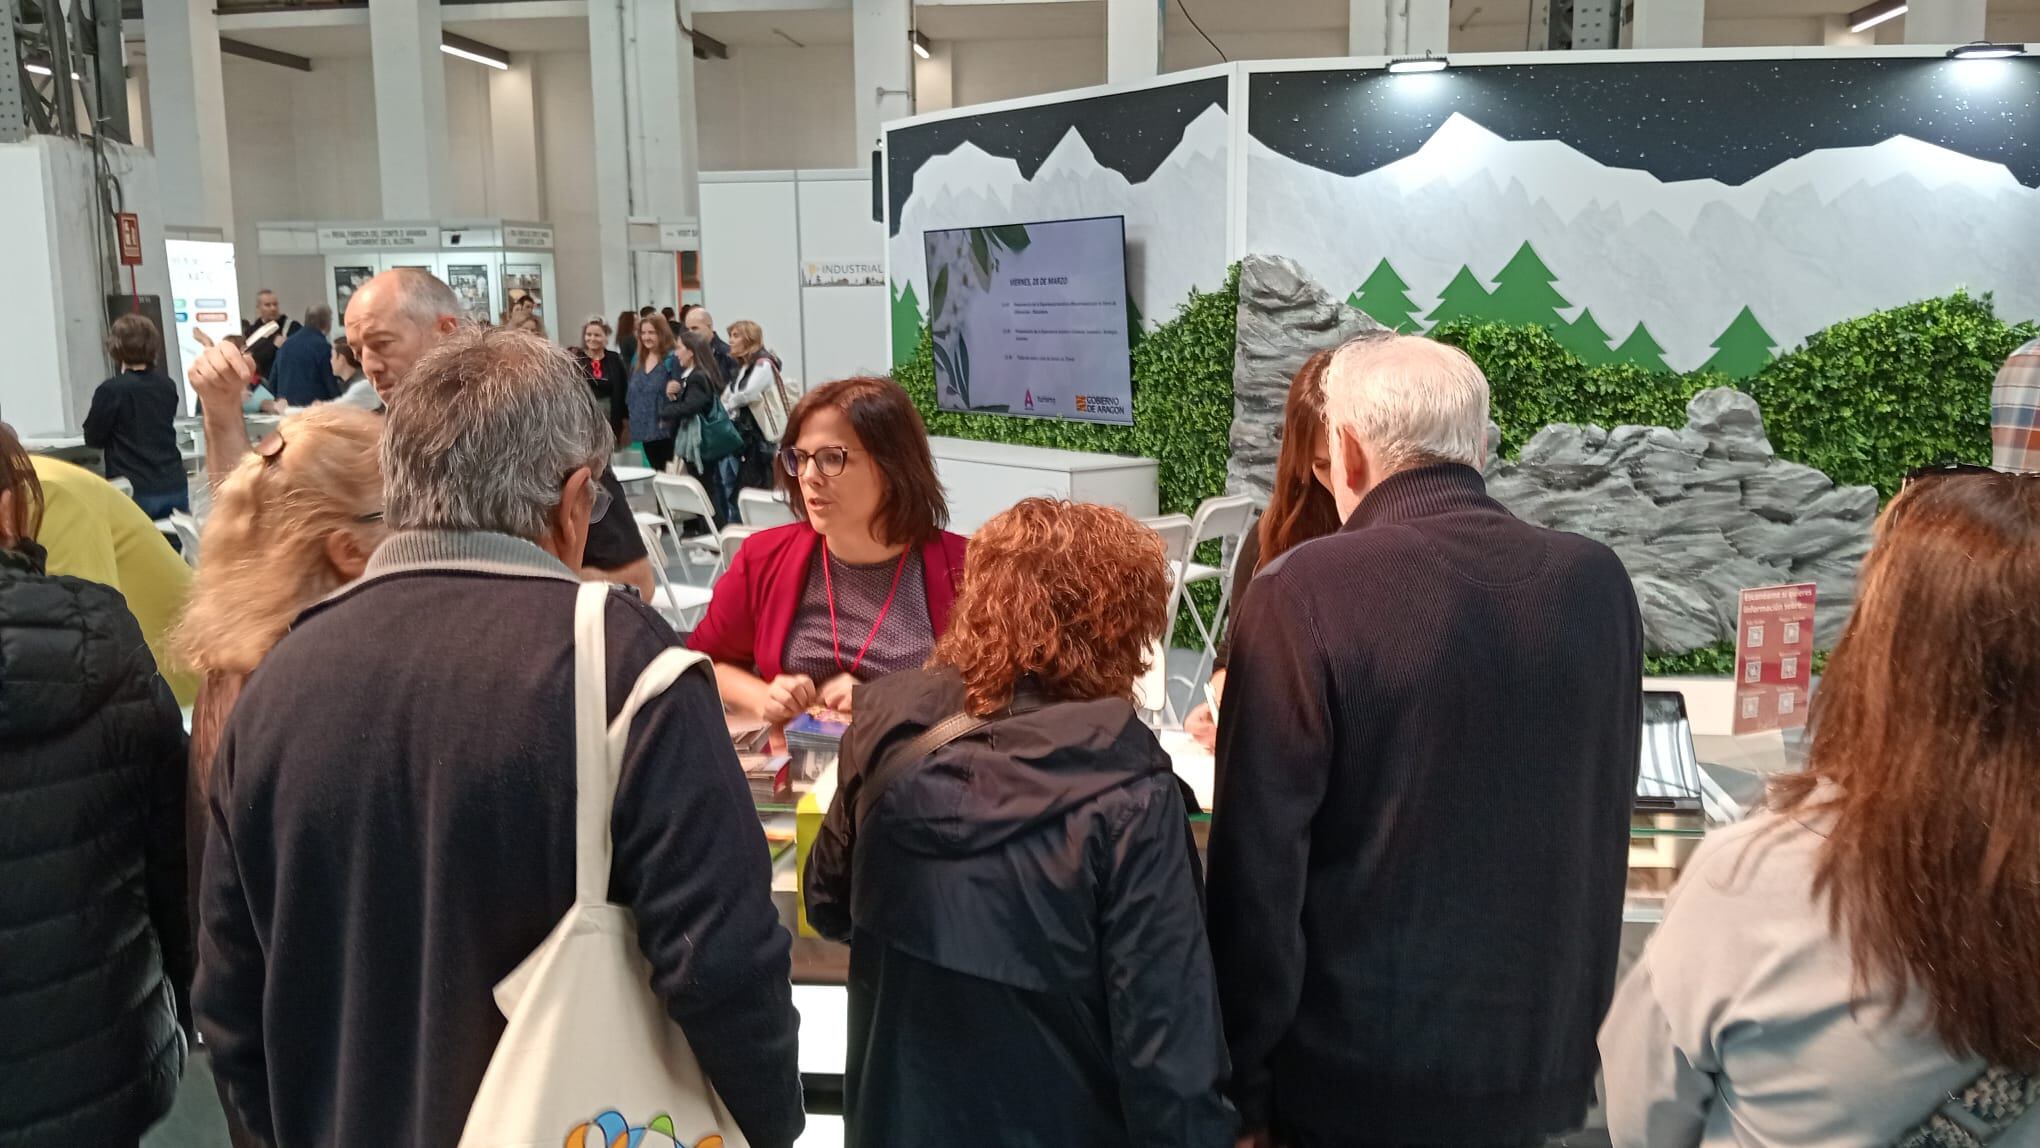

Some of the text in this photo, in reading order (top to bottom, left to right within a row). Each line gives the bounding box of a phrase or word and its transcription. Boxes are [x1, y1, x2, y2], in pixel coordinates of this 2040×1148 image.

[822, 264, 883, 274] INDUSTRIAL
[1040, 277, 1047, 286] DE
[1048, 276, 1068, 285] MARZO
[1086, 395, 1119, 406] GOBIERNO
[1087, 405, 1096, 413] DE
